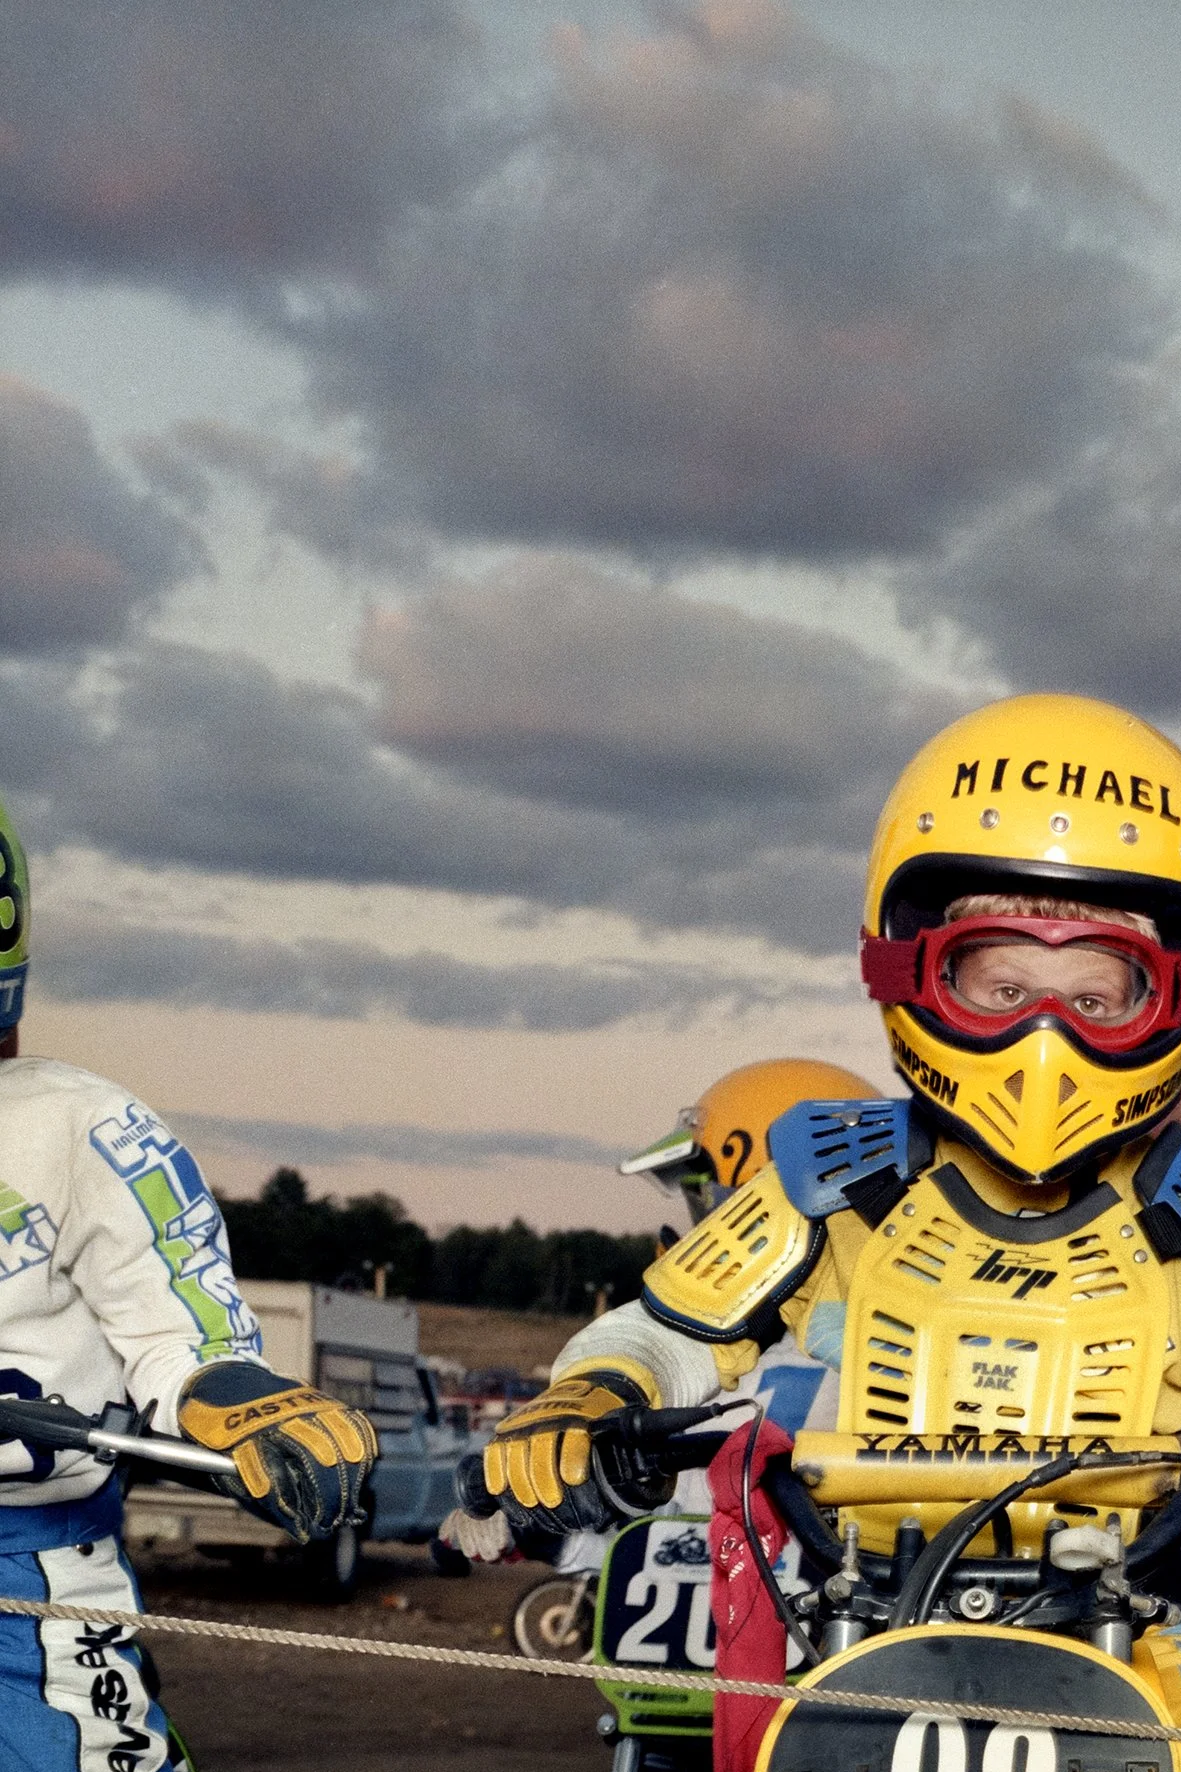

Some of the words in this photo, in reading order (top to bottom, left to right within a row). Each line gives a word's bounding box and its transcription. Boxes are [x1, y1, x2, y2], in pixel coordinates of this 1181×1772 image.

[951, 758, 1181, 826] MICHAEL
[891, 1026, 960, 1106] SIMPSON
[110, 1115, 157, 1151] HALLMA
[972, 1361, 1018, 1379] FLAK
[853, 1433, 1116, 1464] YAMAHA
